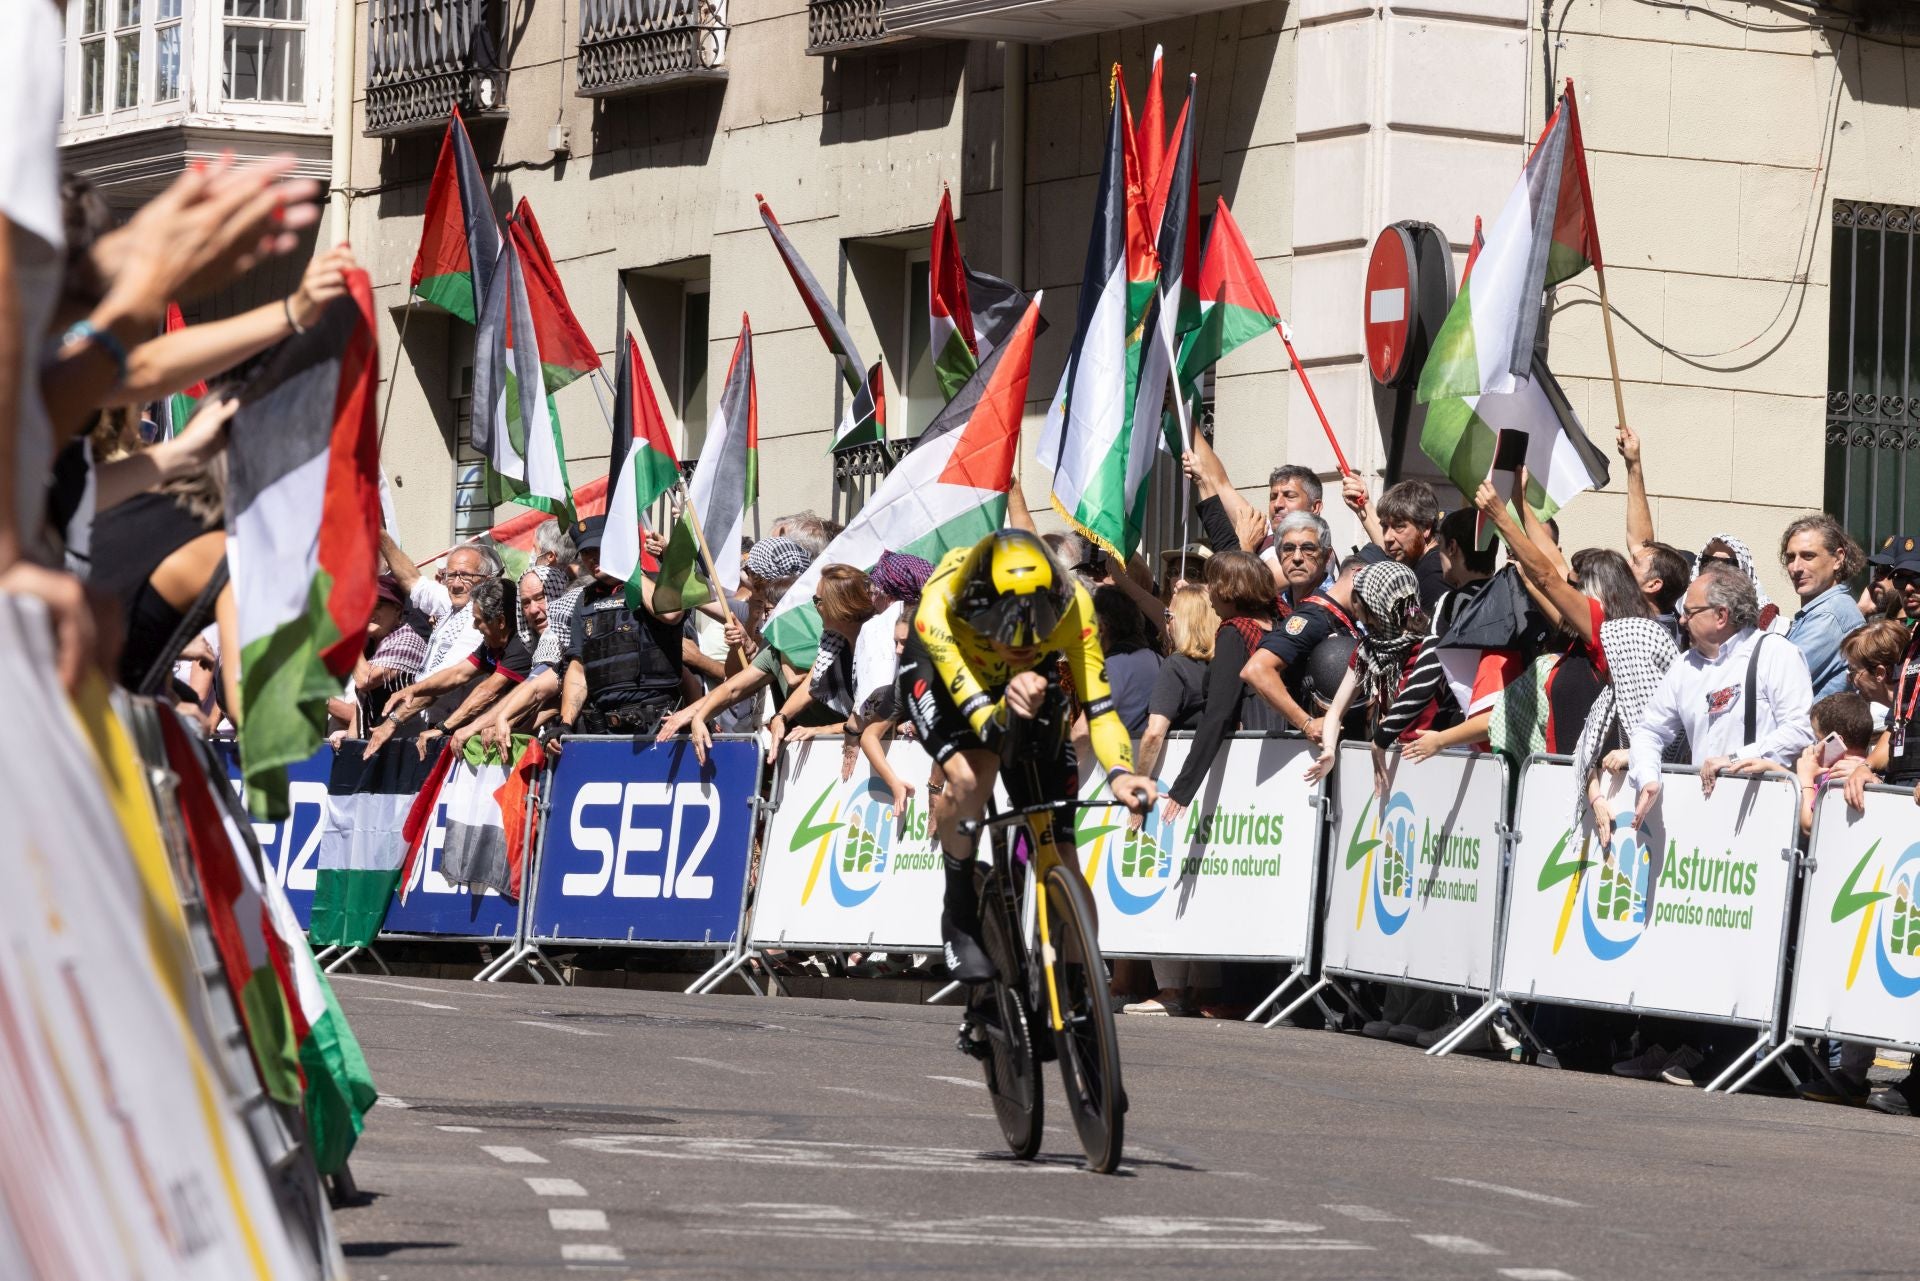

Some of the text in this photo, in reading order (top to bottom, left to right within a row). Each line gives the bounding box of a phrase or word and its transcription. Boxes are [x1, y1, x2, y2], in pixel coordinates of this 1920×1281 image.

[561, 781, 721, 900] SER
[1183, 798, 1284, 846] Asturias
[1419, 815, 1481, 870] Asturias
[893, 846, 935, 875] paraíso
[1180, 849, 1281, 881] paraíso natural
[1659, 837, 1759, 897] Asturias
[1448, 878, 1479, 903] natural
[1654, 896, 1754, 930] paraíso natural
